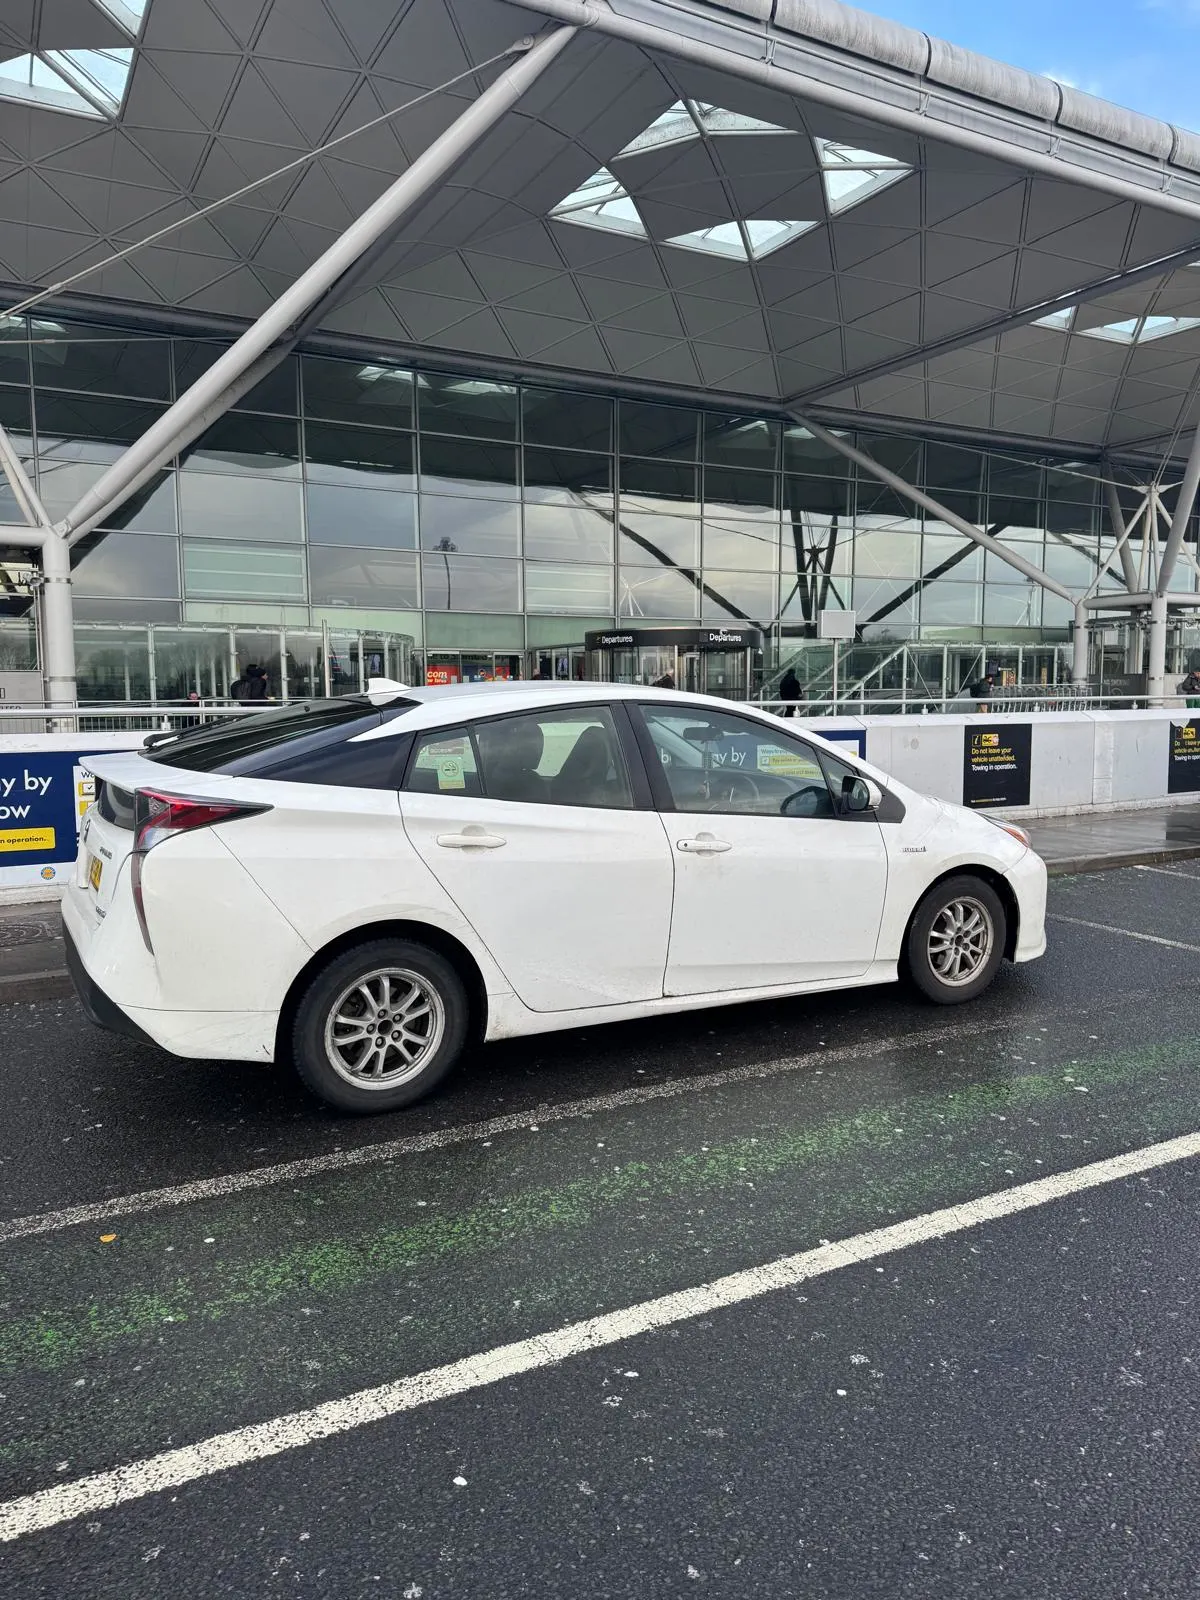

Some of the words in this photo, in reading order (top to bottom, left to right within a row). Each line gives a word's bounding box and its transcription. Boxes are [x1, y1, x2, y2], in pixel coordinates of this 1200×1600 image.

[601, 636, 633, 644] Departures
[709, 633, 742, 642] Departures
[731, 746, 747, 767] by
[0, 778, 17, 797] y
[24, 769, 53, 796] by
[7, 836, 47, 845] operation.
